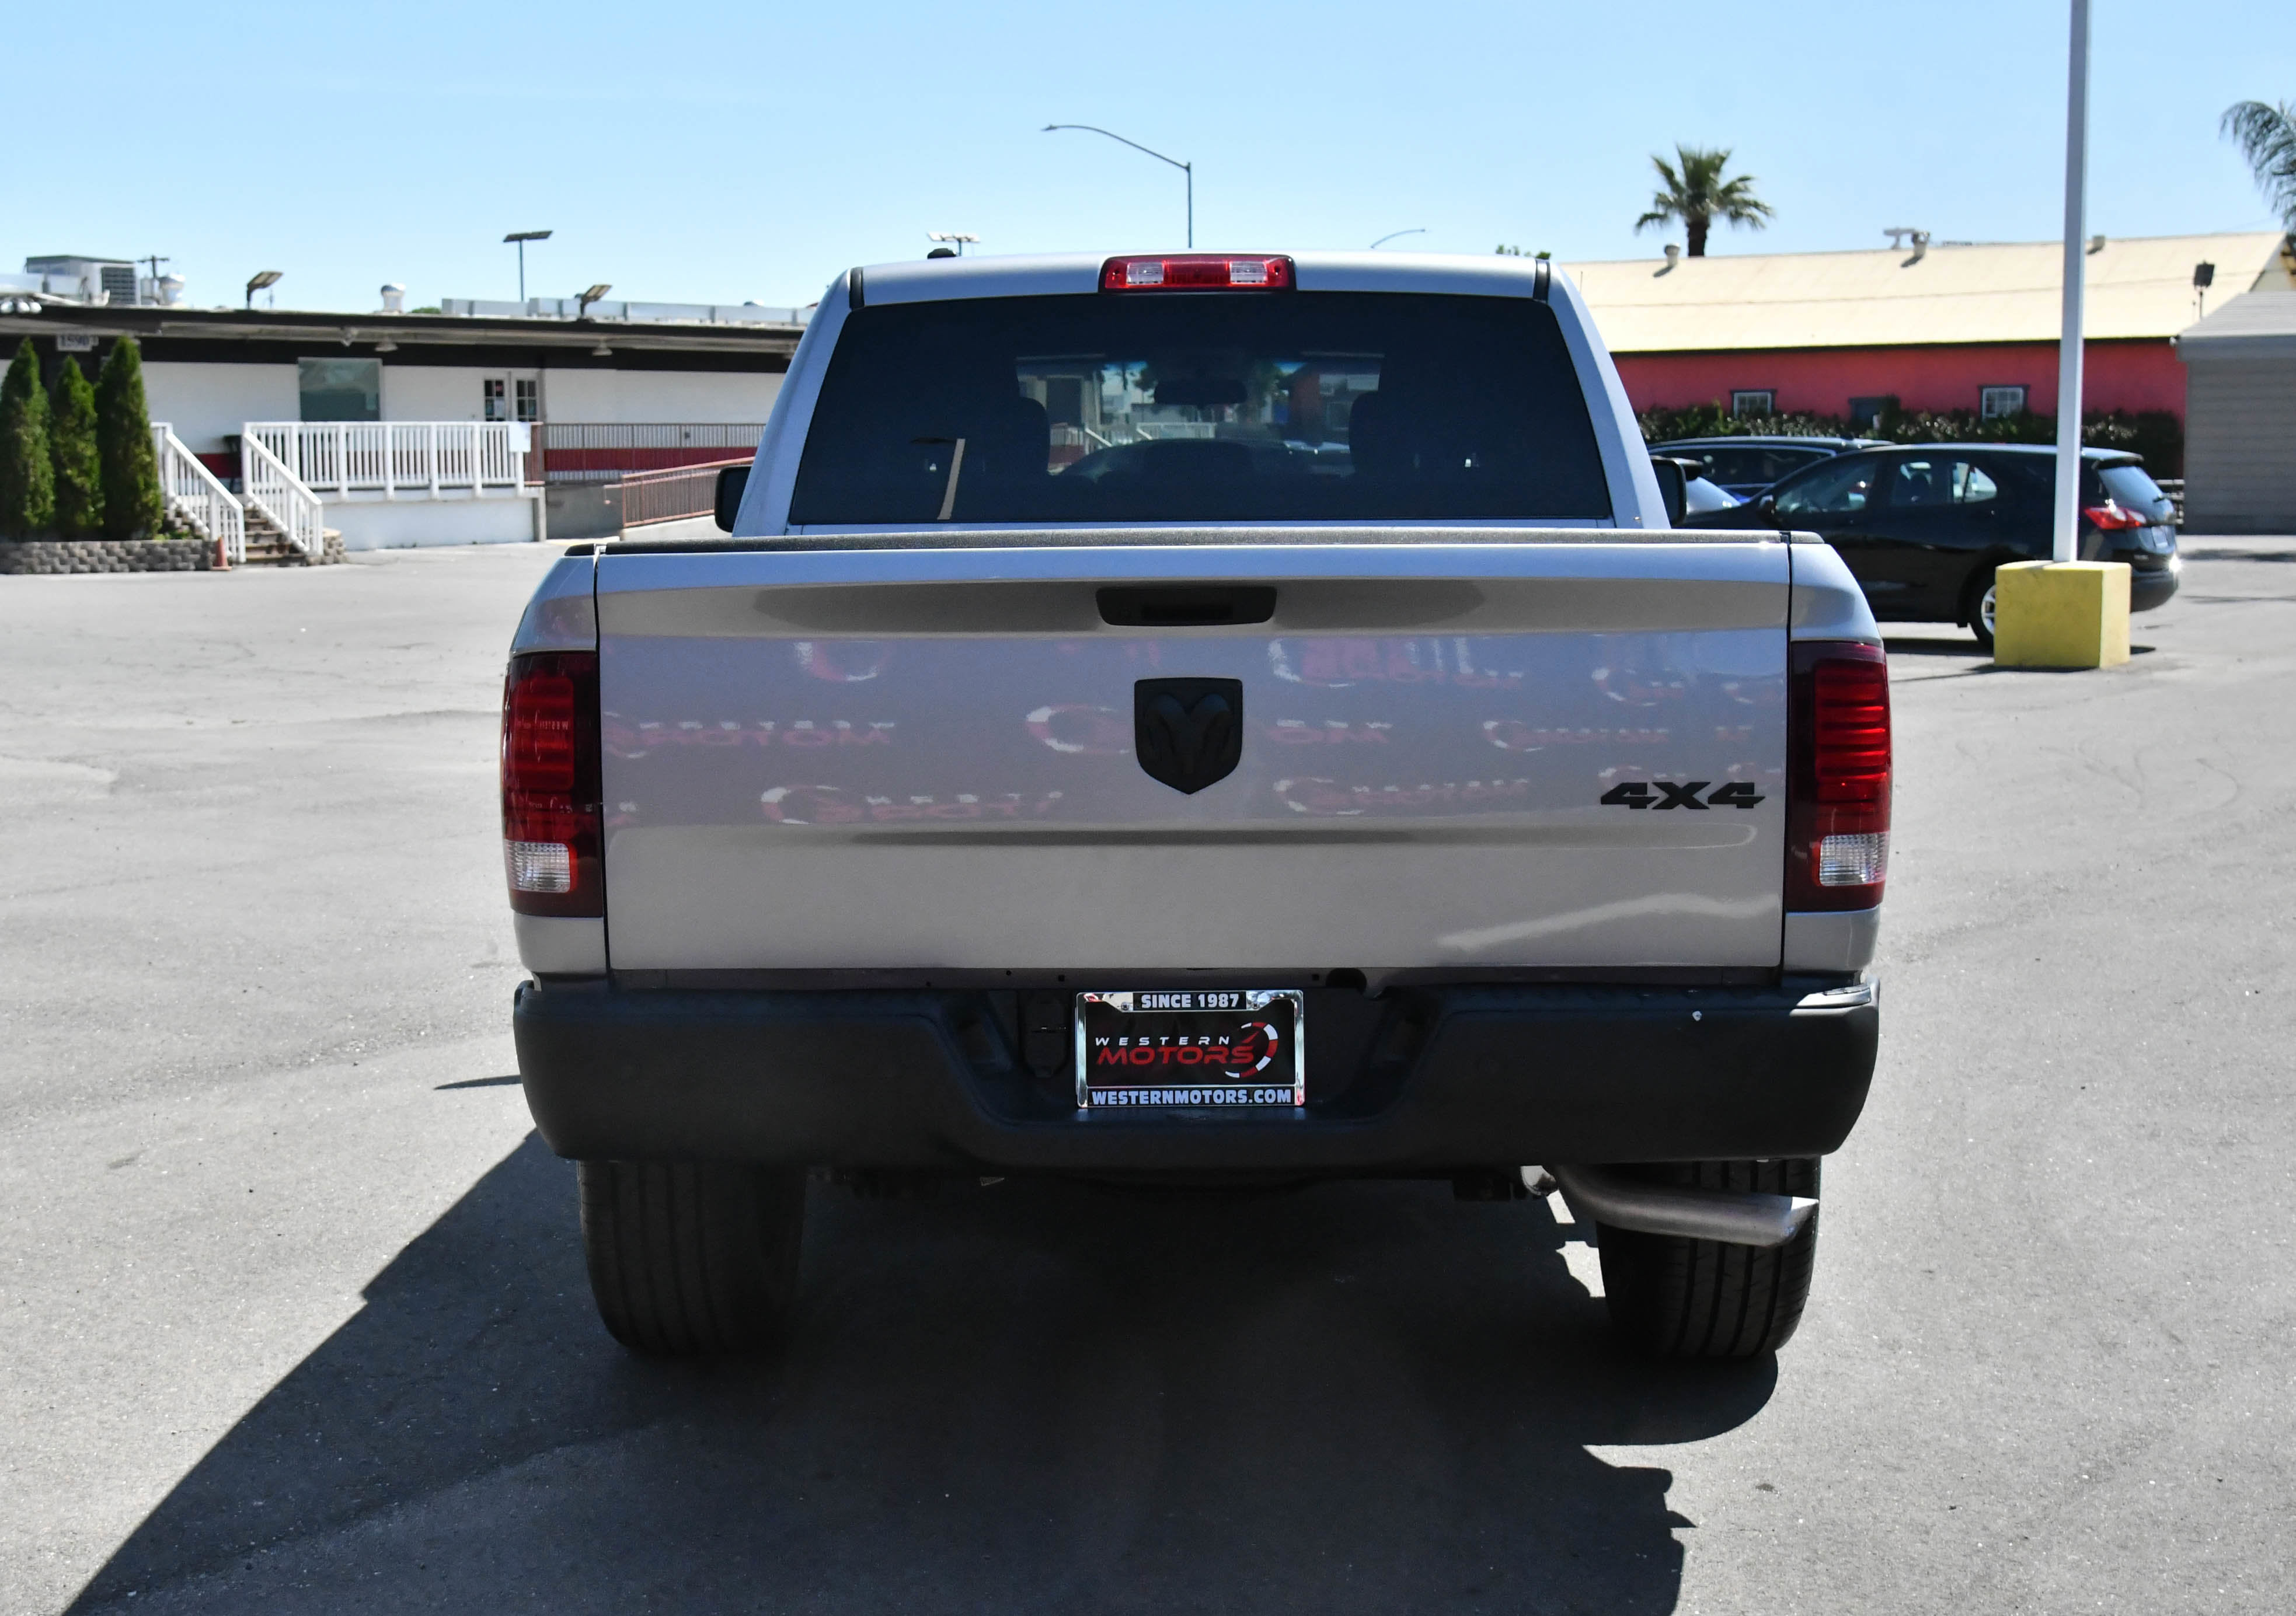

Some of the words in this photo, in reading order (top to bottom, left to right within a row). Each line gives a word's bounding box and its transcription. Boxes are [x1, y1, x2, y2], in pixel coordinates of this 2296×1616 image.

[1600, 781, 1766, 809] 4X4
[1141, 994, 1191, 1009] SINCE
[1197, 993, 1239, 1008] 1987
[1095, 1036, 1230, 1046] WESTERN
[1096, 1045, 1255, 1065] MOTORS
[1092, 1089, 1291, 1105] WESTERNMOTORS.COM
